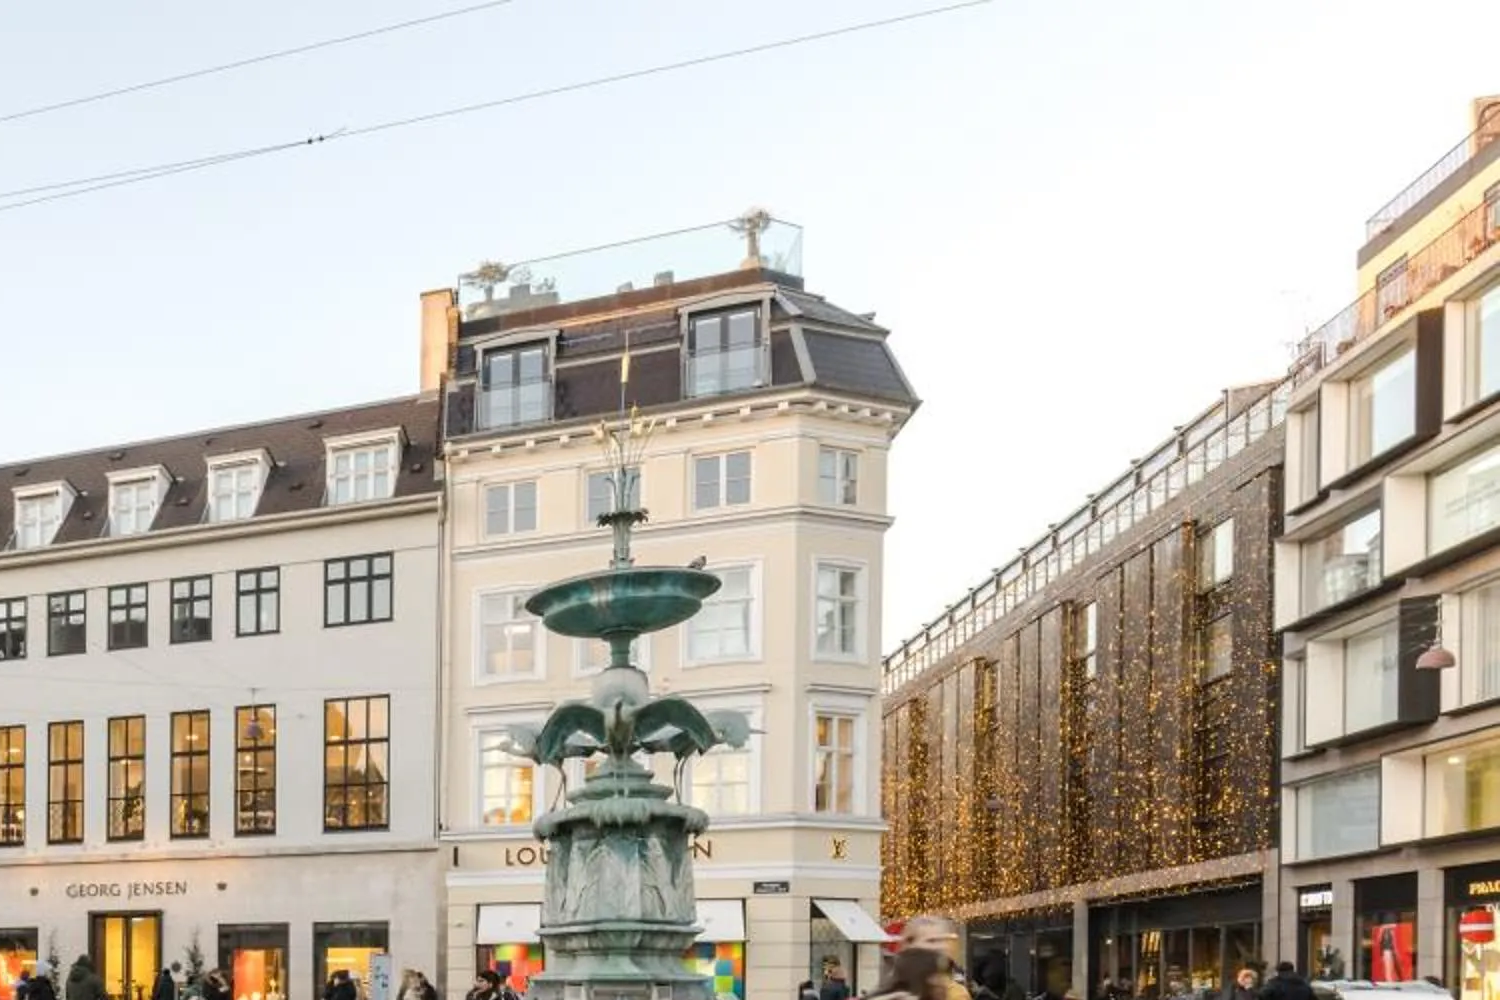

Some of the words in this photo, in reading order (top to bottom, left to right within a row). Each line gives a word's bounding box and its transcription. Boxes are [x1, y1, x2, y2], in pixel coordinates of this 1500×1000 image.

[505, 846, 549, 866] LOU
[65, 882, 121, 898] GEORG
[126, 881, 187, 900] JENSEN
